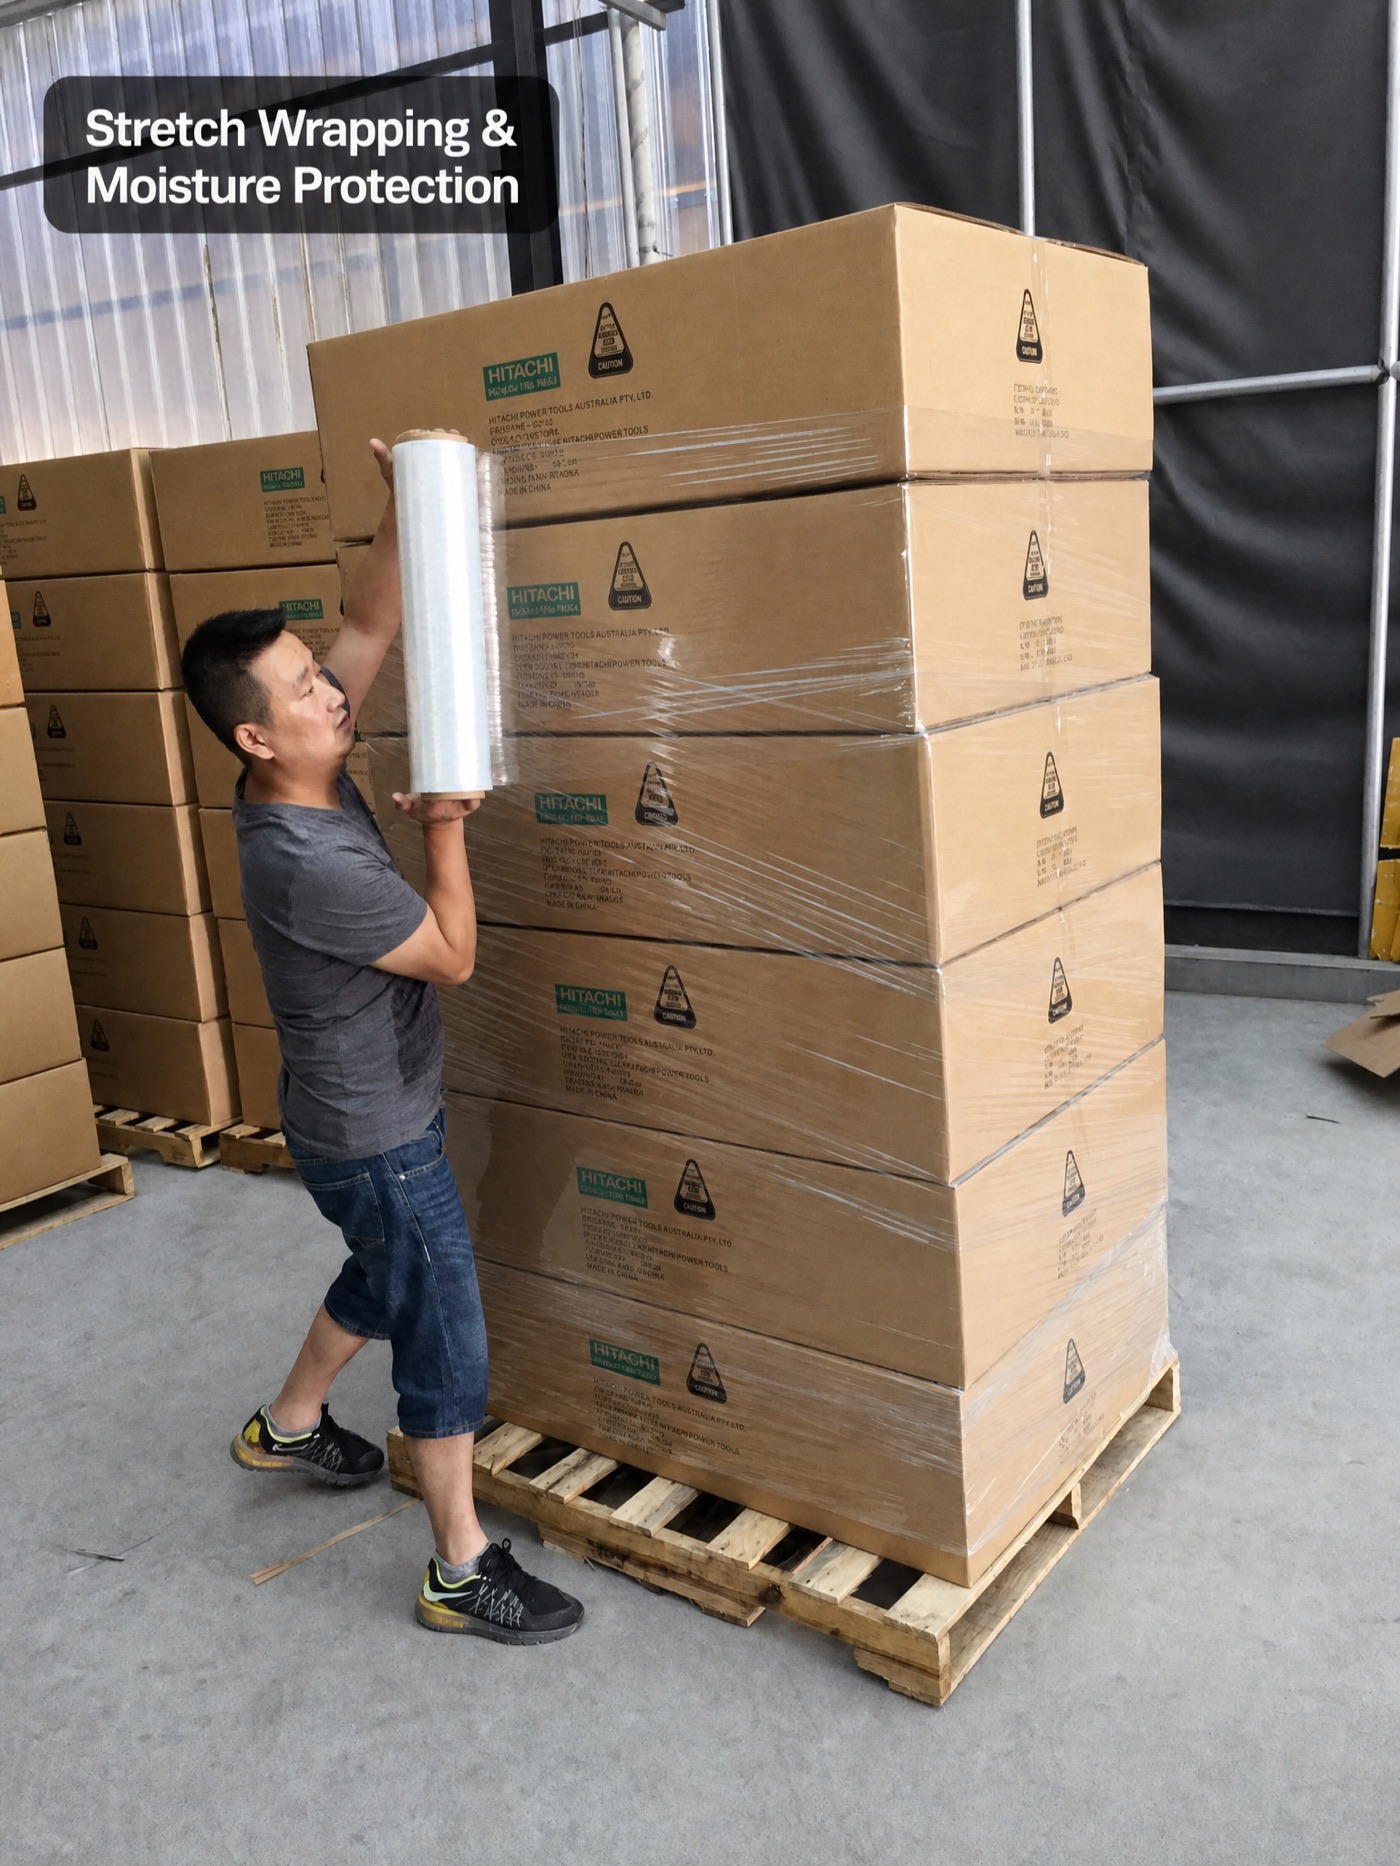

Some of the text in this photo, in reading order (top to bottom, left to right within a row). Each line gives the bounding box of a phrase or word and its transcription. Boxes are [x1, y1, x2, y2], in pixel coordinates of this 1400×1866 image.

[488, 357, 554, 384] HITACHI
[597, 358, 624, 371] CAUTION
[488, 411, 519, 425] HITACHI
[520, 407, 547, 419] POWER
[550, 403, 574, 415] TOOLS
[575, 396, 618, 411] AUSTRALIA
[594, 429, 623, 440] POWER
[624, 425, 649, 435] TOOLS
[262, 469, 301, 482] HITACHI
[511, 586, 575, 604] HITACHI
[617, 594, 642, 604] CAUTION
[512, 632, 542, 642] HITACHI
[542, 631, 569, 641] POWER
[570, 630, 595, 640] TOOLS
[596, 628, 637, 639] AUSTRALIA
[613, 659, 641, 669] POWER
[539, 795, 603, 811] HITACHI
[560, 987, 621, 1007] HITACHI
[590, 1030, 618, 1041] POWER
[618, 1034, 644, 1046] TOOLS
[685, 1071, 710, 1084] TOOLS
[581, 1170, 643, 1194] HITACHI
[611, 1212, 638, 1225] POWER
[638, 1219, 663, 1232] TOOLS
[663, 1226, 702, 1240] AUSTRALIA
[676, 1253, 704, 1266] POWER
[704, 1260, 729, 1273] TOOLS
[594, 1341, 655, 1371] HITACHI
[652, 1395, 677, 1410] TOOLS
[677, 1404, 716, 1422] AUSTRALIA
